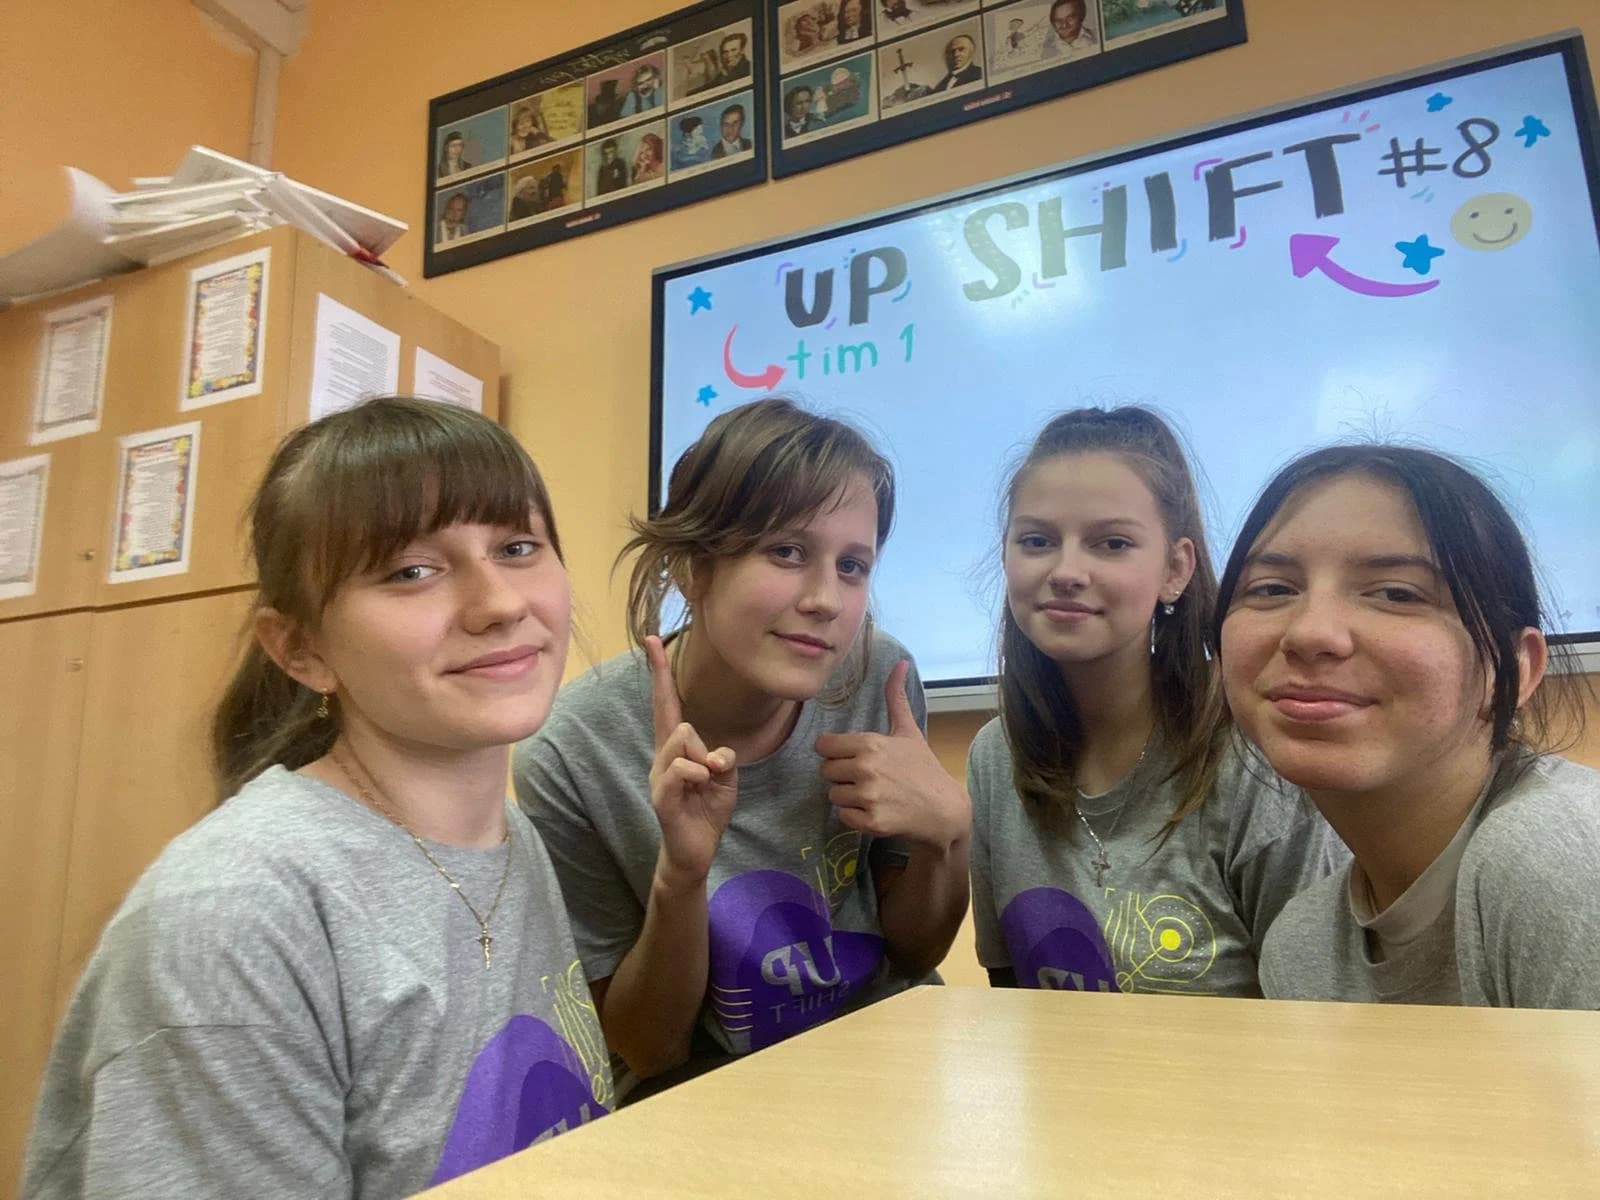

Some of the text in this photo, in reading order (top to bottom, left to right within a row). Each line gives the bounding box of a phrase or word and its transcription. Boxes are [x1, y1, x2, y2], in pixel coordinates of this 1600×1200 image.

[785, 117, 1500, 328] UP SHIFT #8
[787, 323, 915, 380] tim 1
